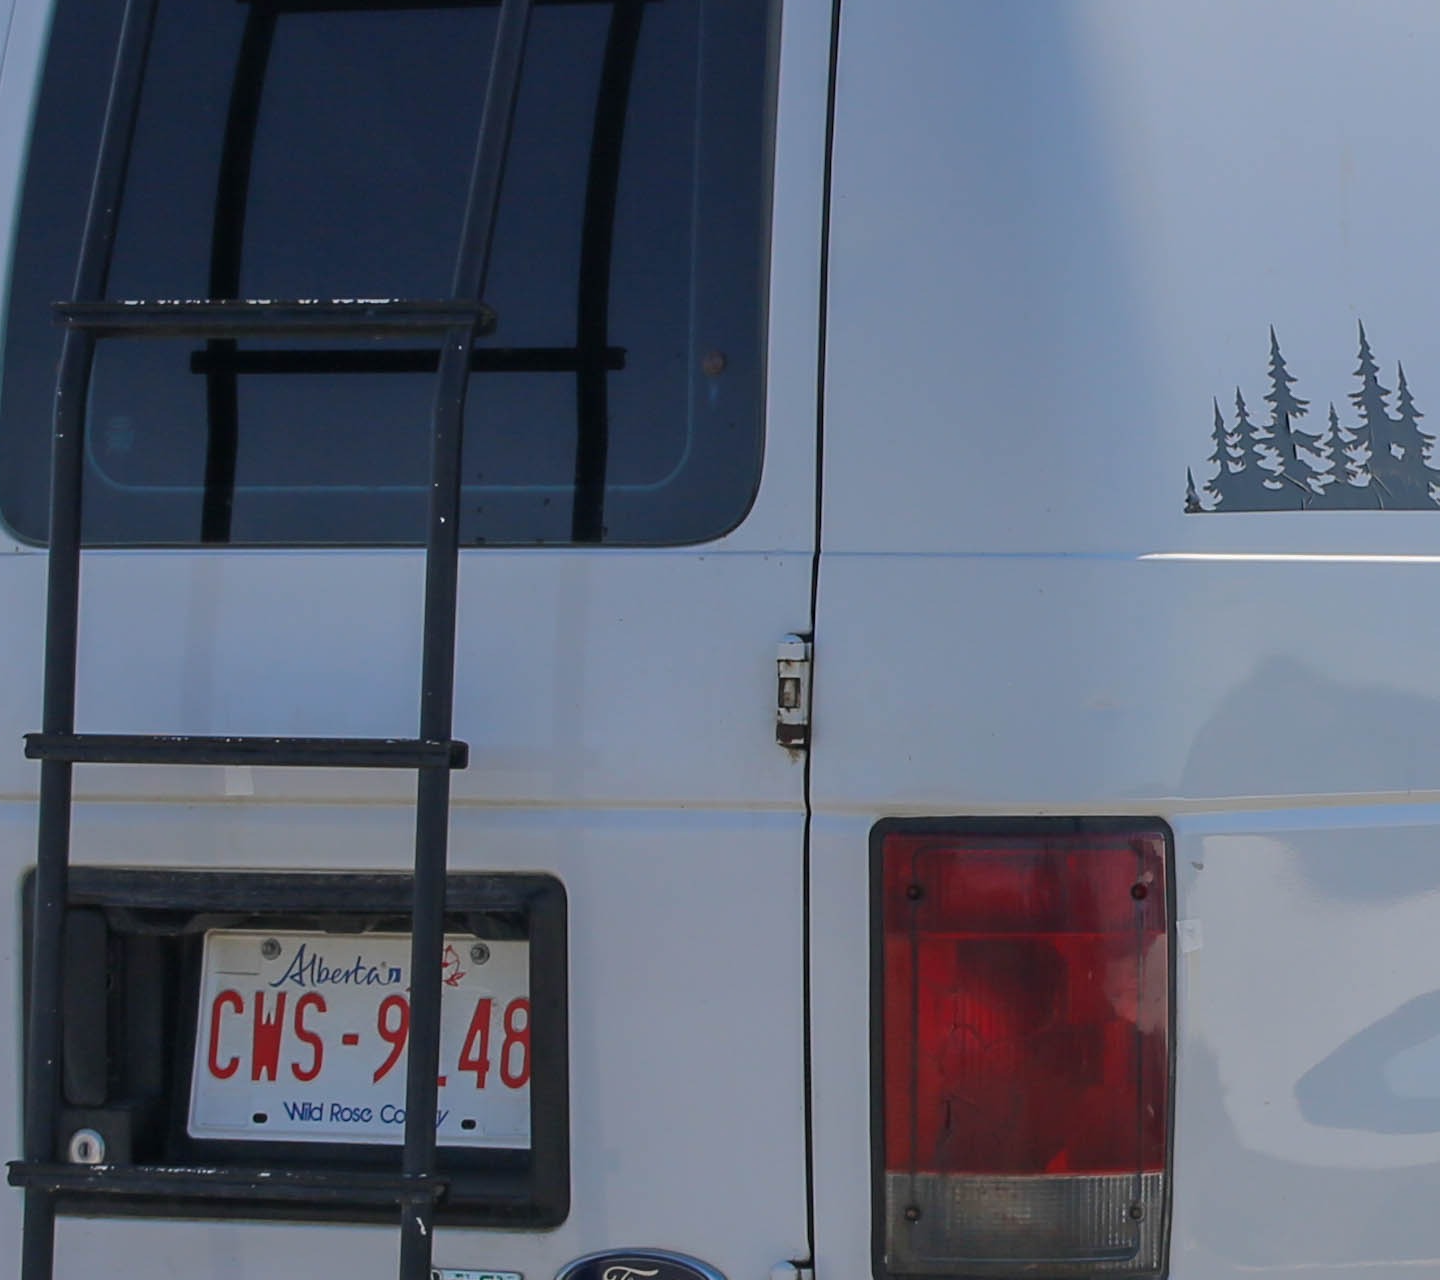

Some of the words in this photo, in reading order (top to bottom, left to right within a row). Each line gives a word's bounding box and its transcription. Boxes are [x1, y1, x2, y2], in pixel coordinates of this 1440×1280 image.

[269, 943, 389, 988] Alberta
[207, 989, 531, 1090] CWS-948
[283, 1101, 324, 1122] Wild
[329, 1102, 373, 1123] Rose
